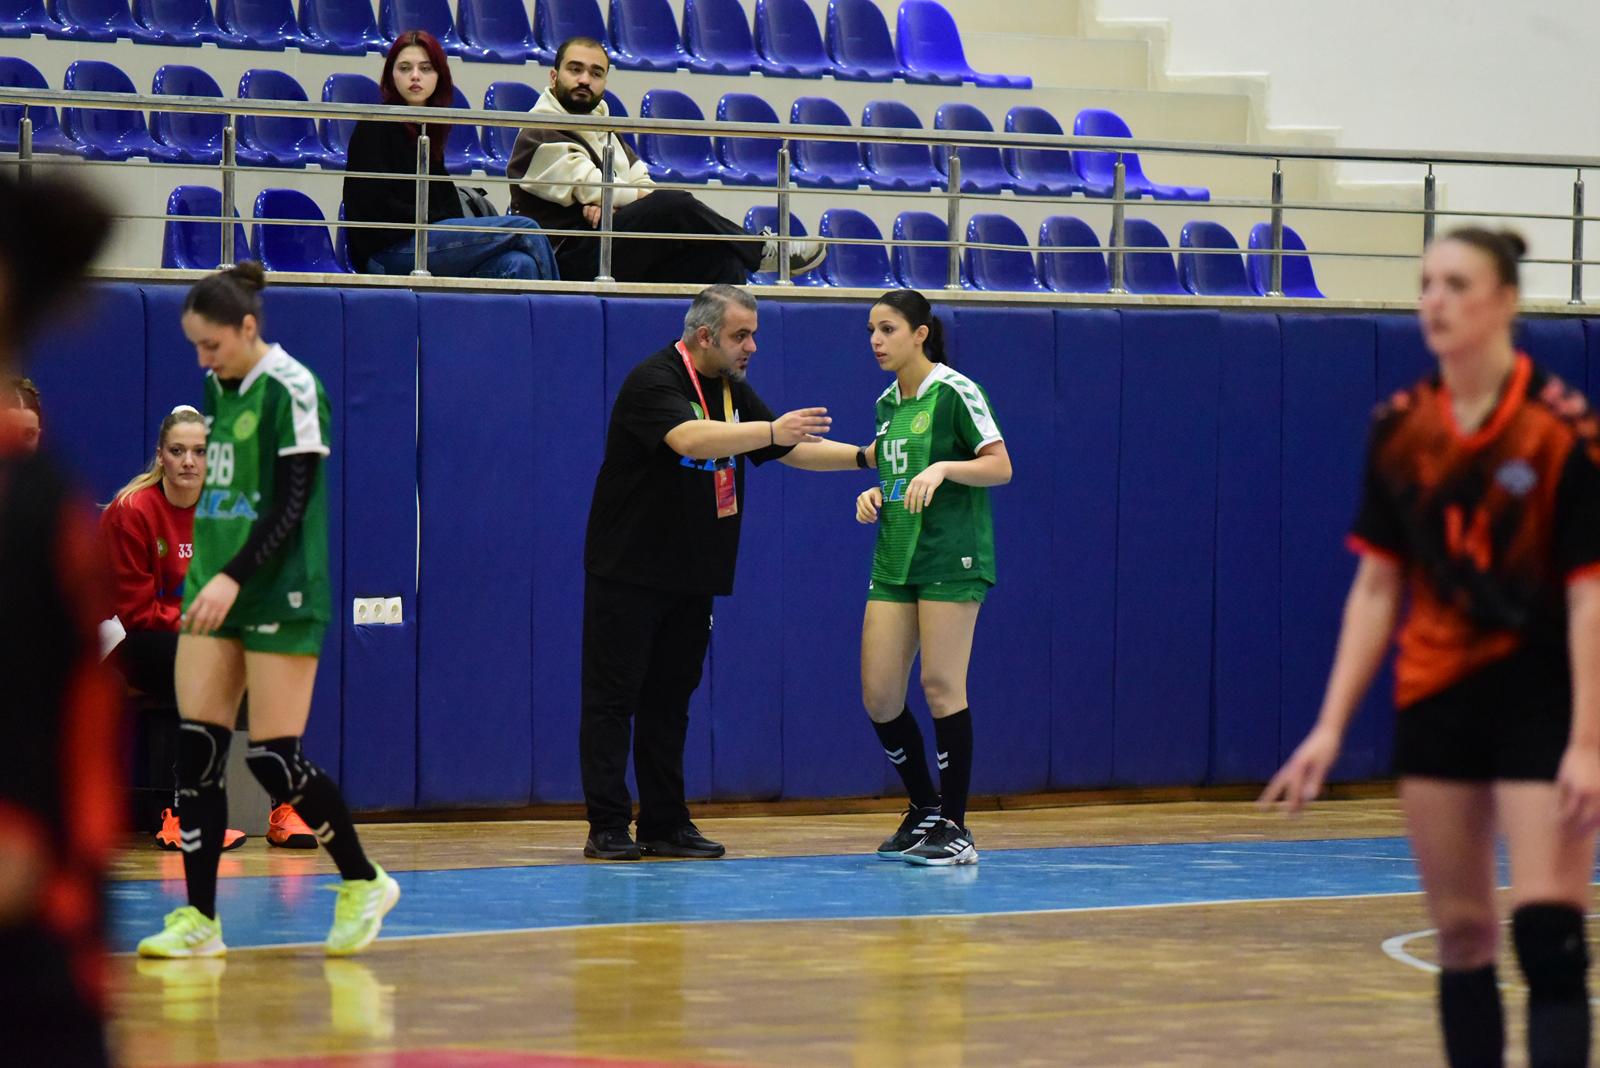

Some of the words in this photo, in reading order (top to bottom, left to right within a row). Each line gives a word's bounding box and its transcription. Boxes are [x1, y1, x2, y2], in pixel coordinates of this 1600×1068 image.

[206, 441, 234, 486] 98
[883, 438, 908, 475] 45
[178, 543, 193, 558] 33
